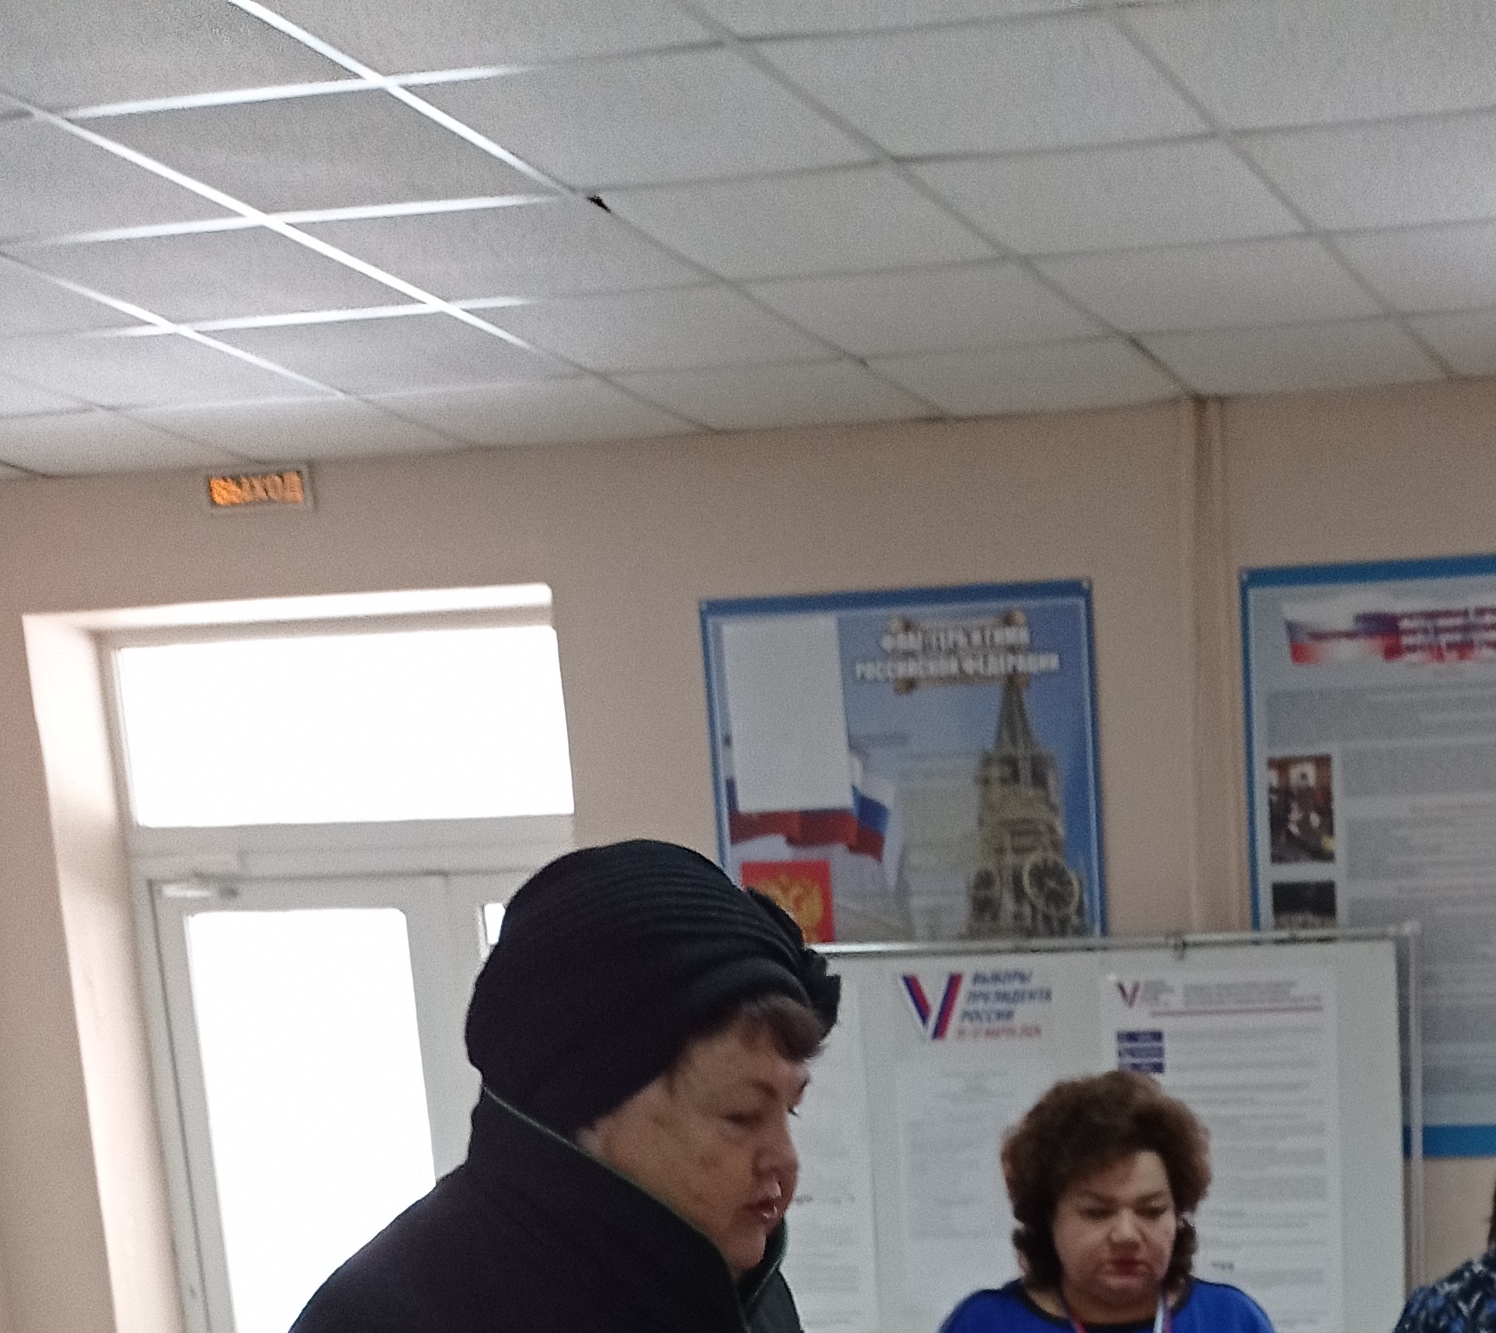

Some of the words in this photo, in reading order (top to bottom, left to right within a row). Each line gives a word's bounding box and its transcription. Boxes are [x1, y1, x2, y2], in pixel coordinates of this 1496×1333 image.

[208, 471, 304, 506] ВЫХОД
[973, 970, 1033, 986] ВЫБОРЫ
[967, 987, 1053, 1004] ПРЕЗИДЕНТА
[961, 1008, 1016, 1023] РОССИИ
